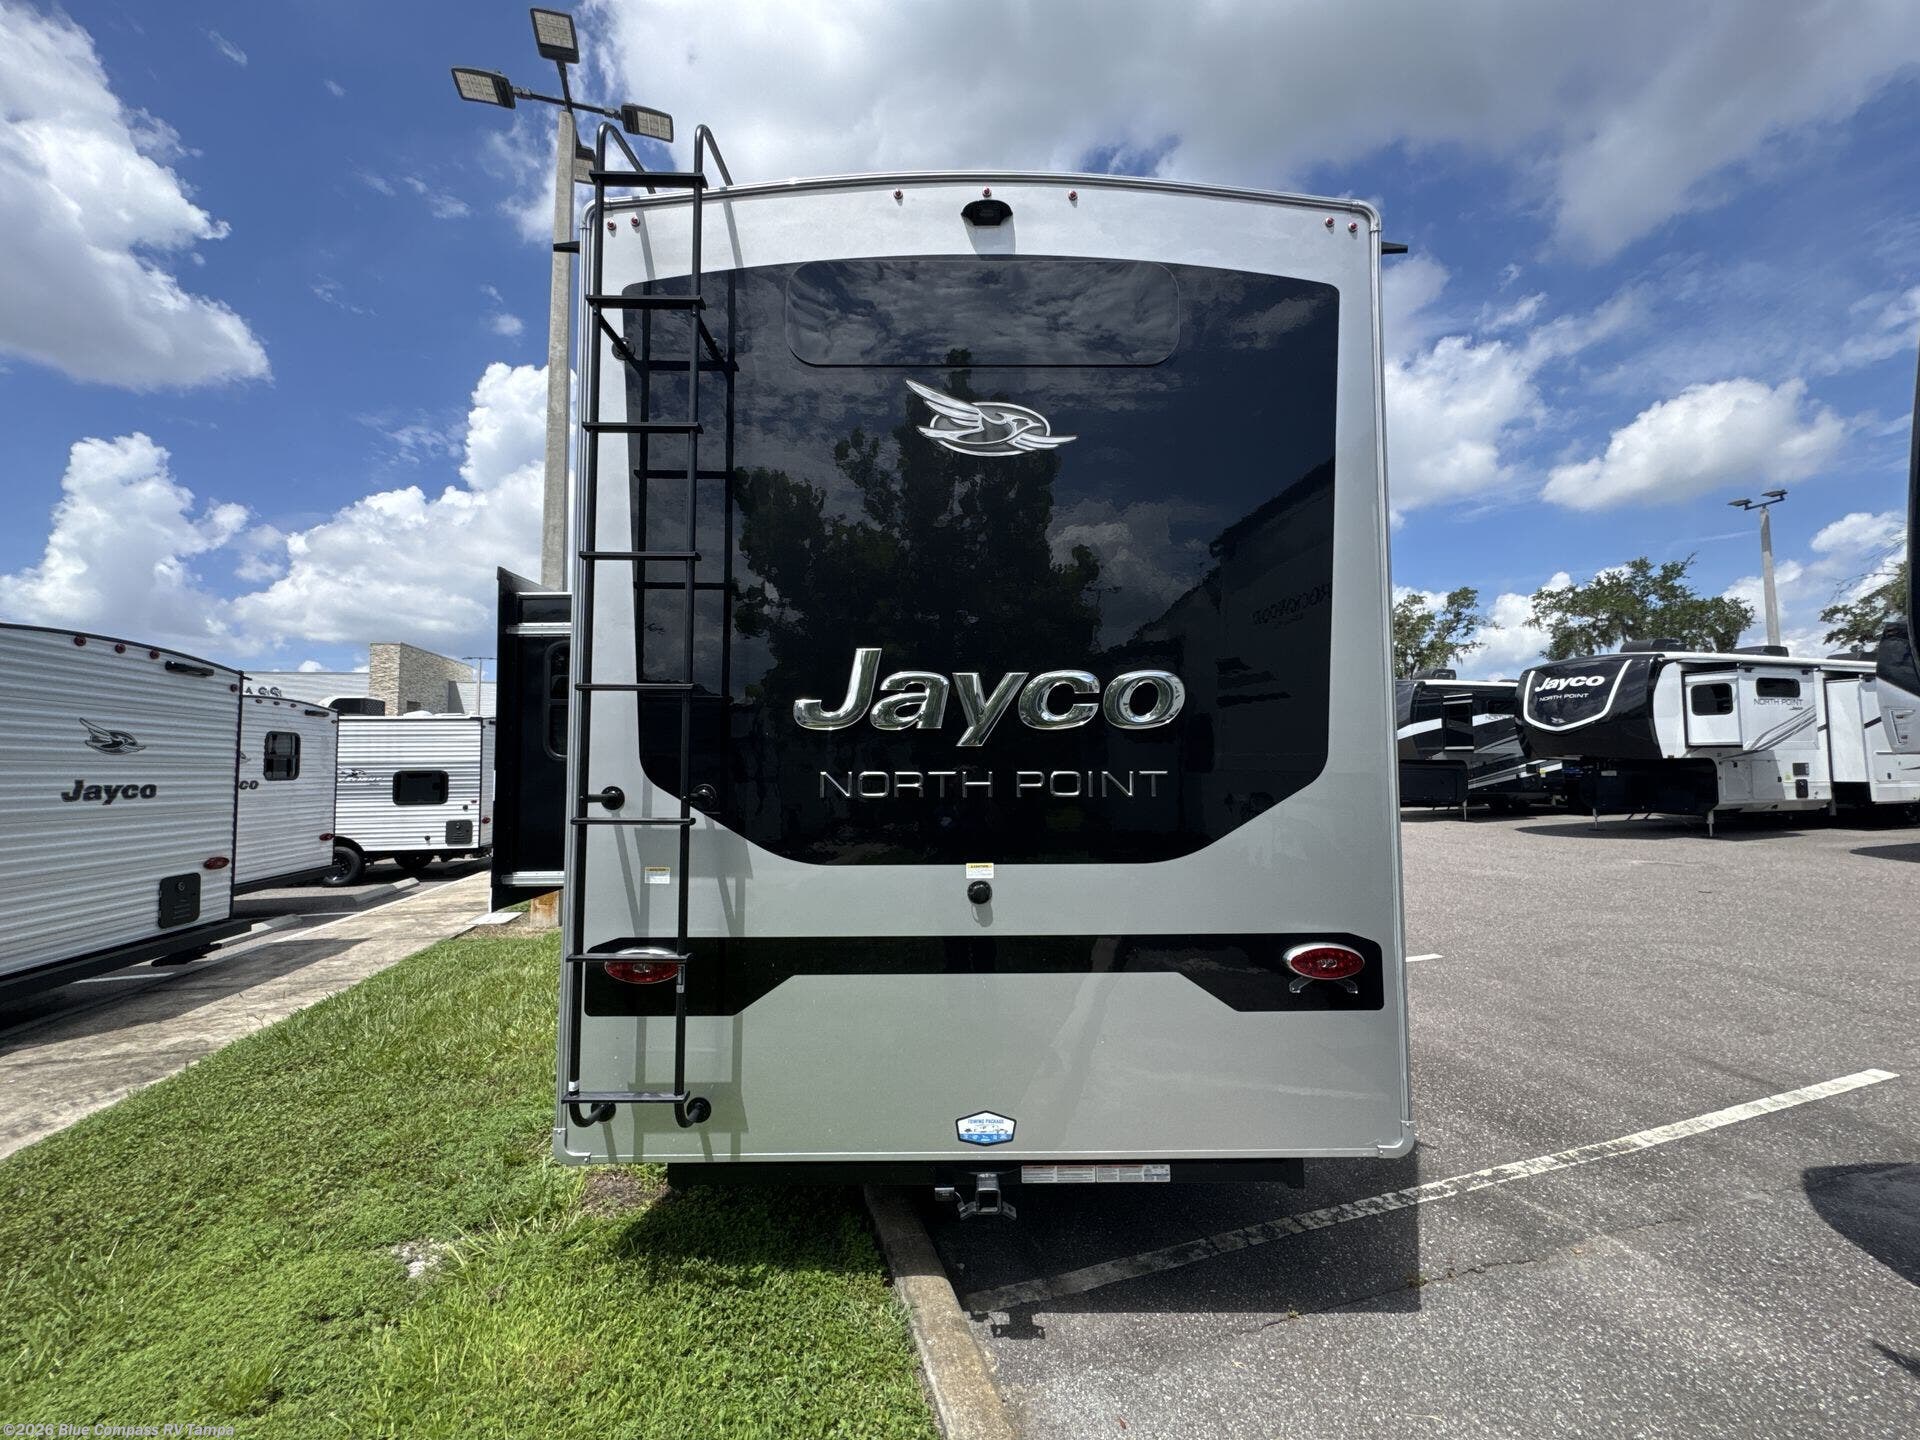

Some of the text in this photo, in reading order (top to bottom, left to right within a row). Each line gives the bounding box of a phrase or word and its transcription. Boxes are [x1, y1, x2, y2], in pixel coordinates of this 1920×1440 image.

[793, 647, 1186, 747] Jayco
[1535, 676, 1605, 692] Jayco
[61, 779, 158, 805] Jayco
[819, 770, 1168, 798] NORTH POINT
